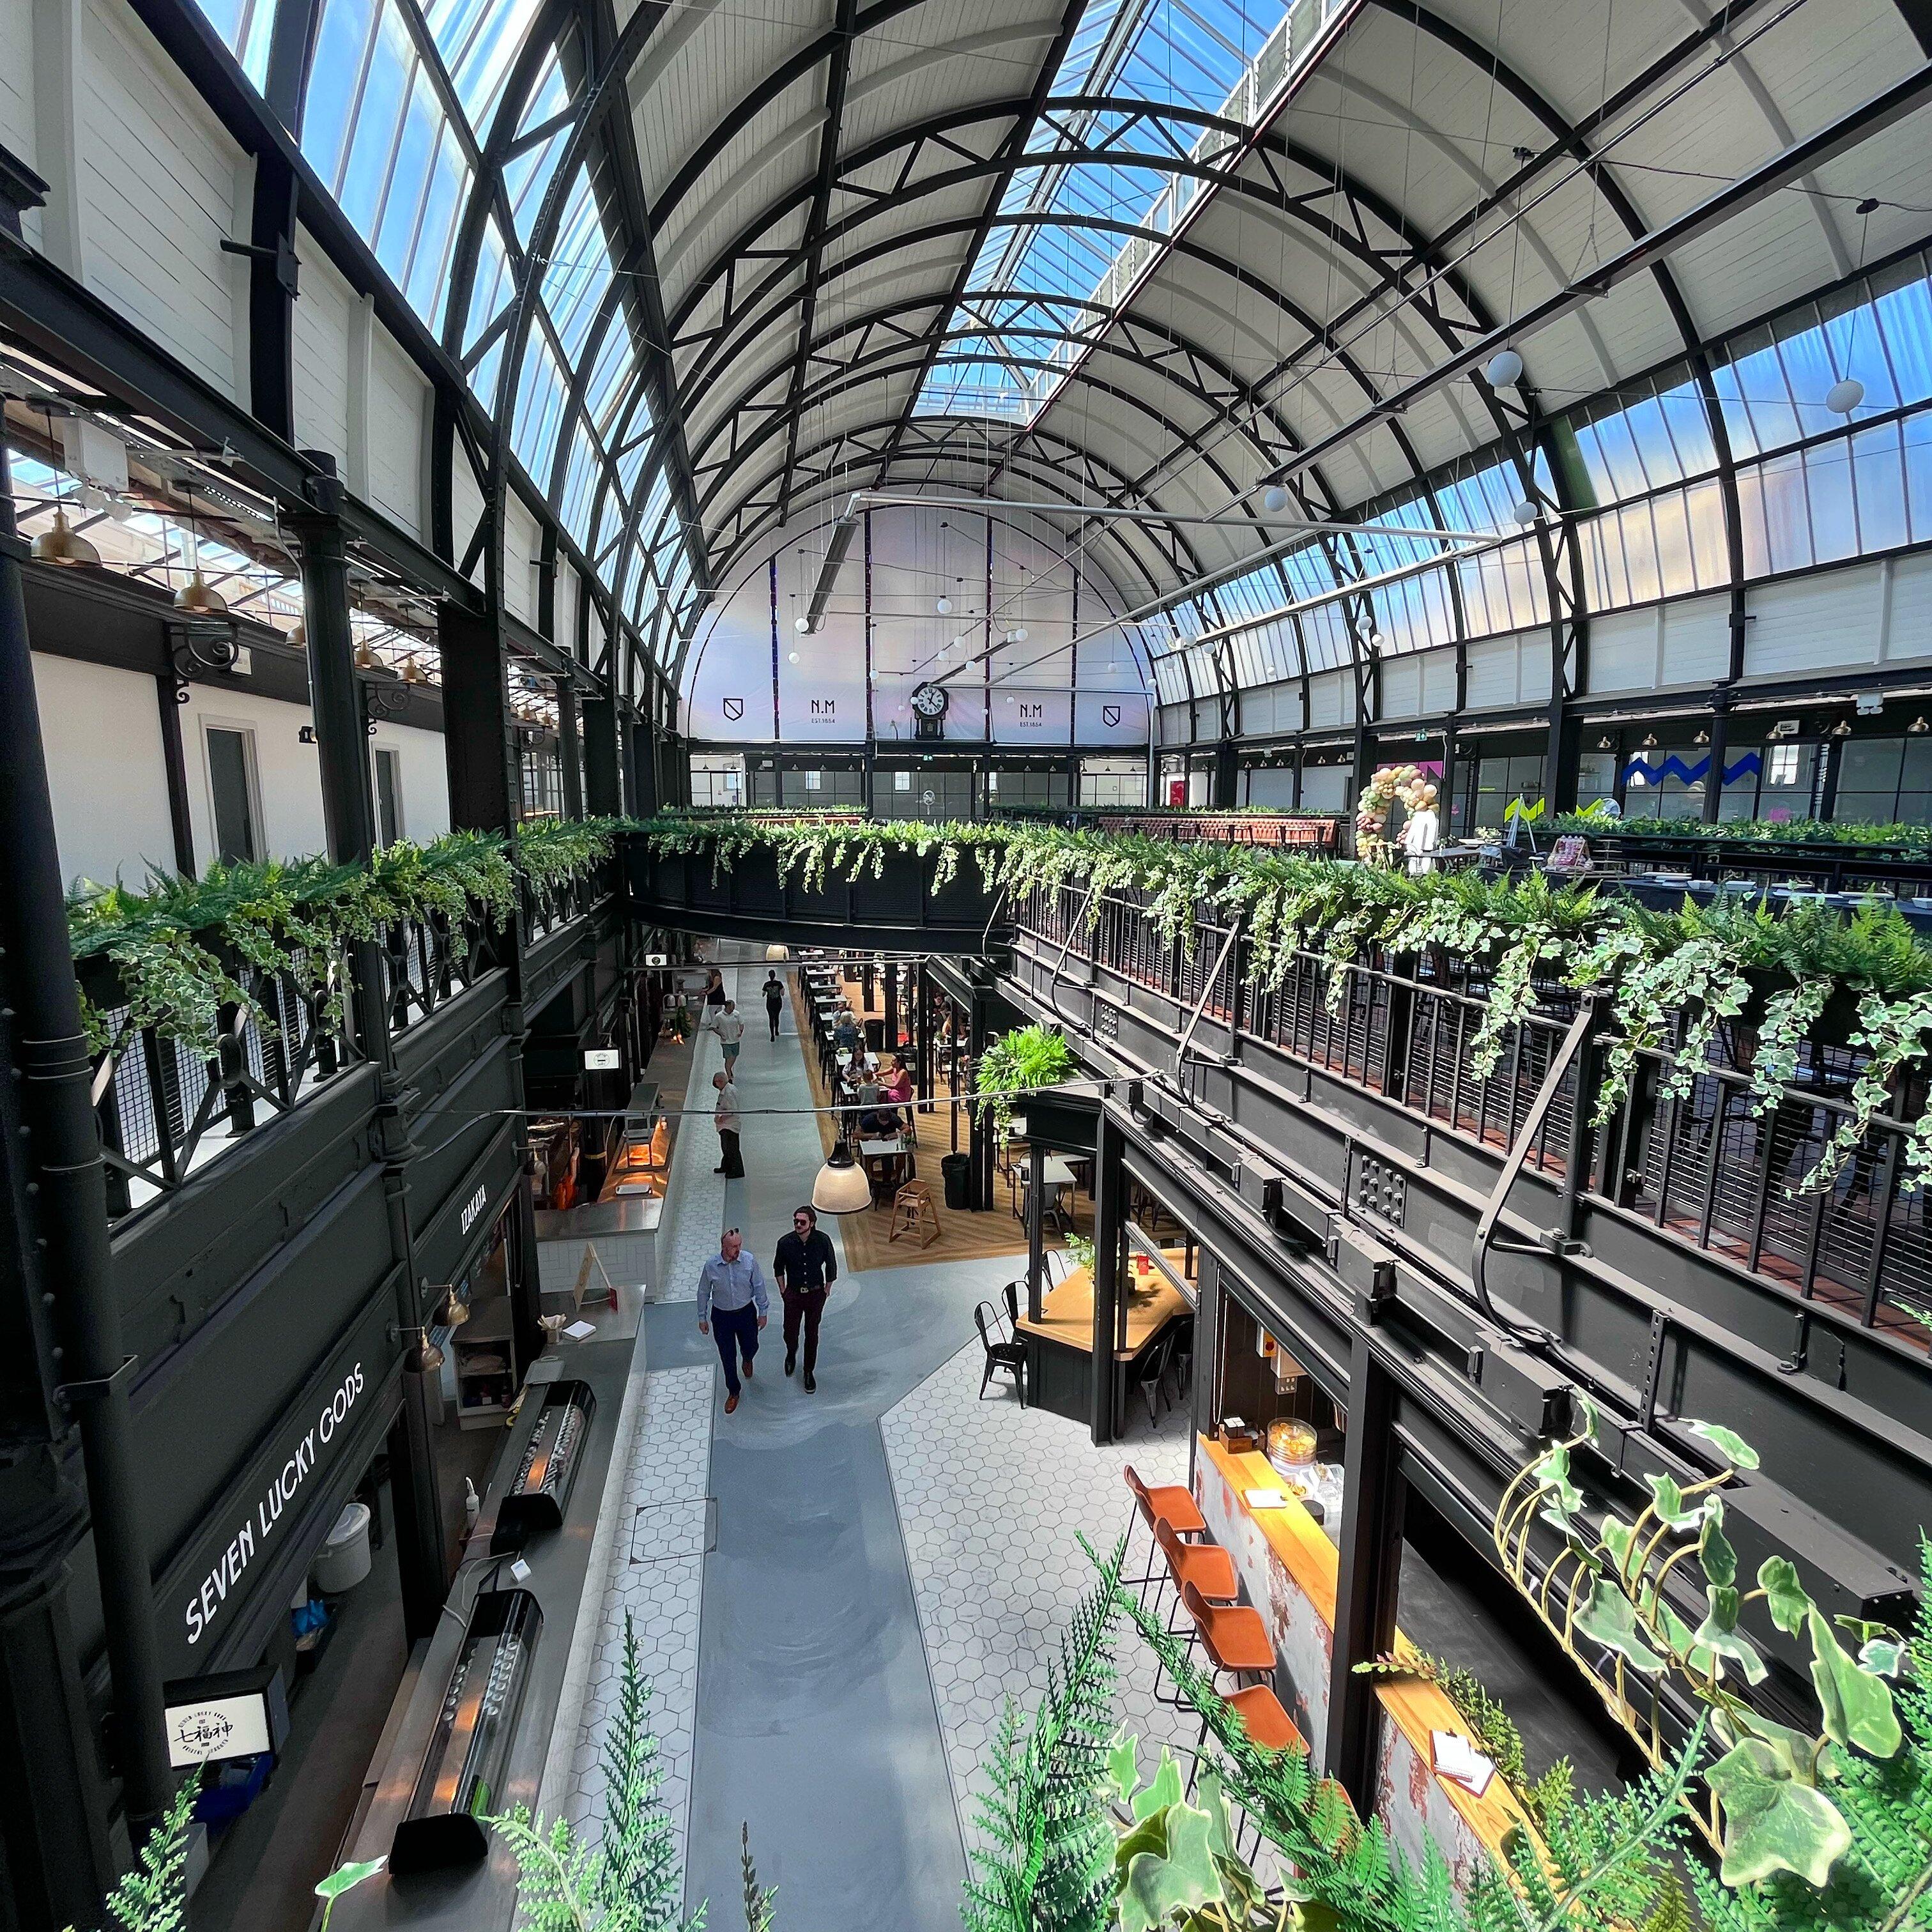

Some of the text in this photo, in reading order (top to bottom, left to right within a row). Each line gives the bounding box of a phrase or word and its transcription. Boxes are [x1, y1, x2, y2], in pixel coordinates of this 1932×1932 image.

[461, 1184, 487, 1235] IZAKAYA
[186, 1519, 254, 1644] SEVEN
[259, 1428, 315, 1538] LUCKY
[319, 1361, 365, 1443] GODS
[174, 1721, 233, 1742] 七福神
